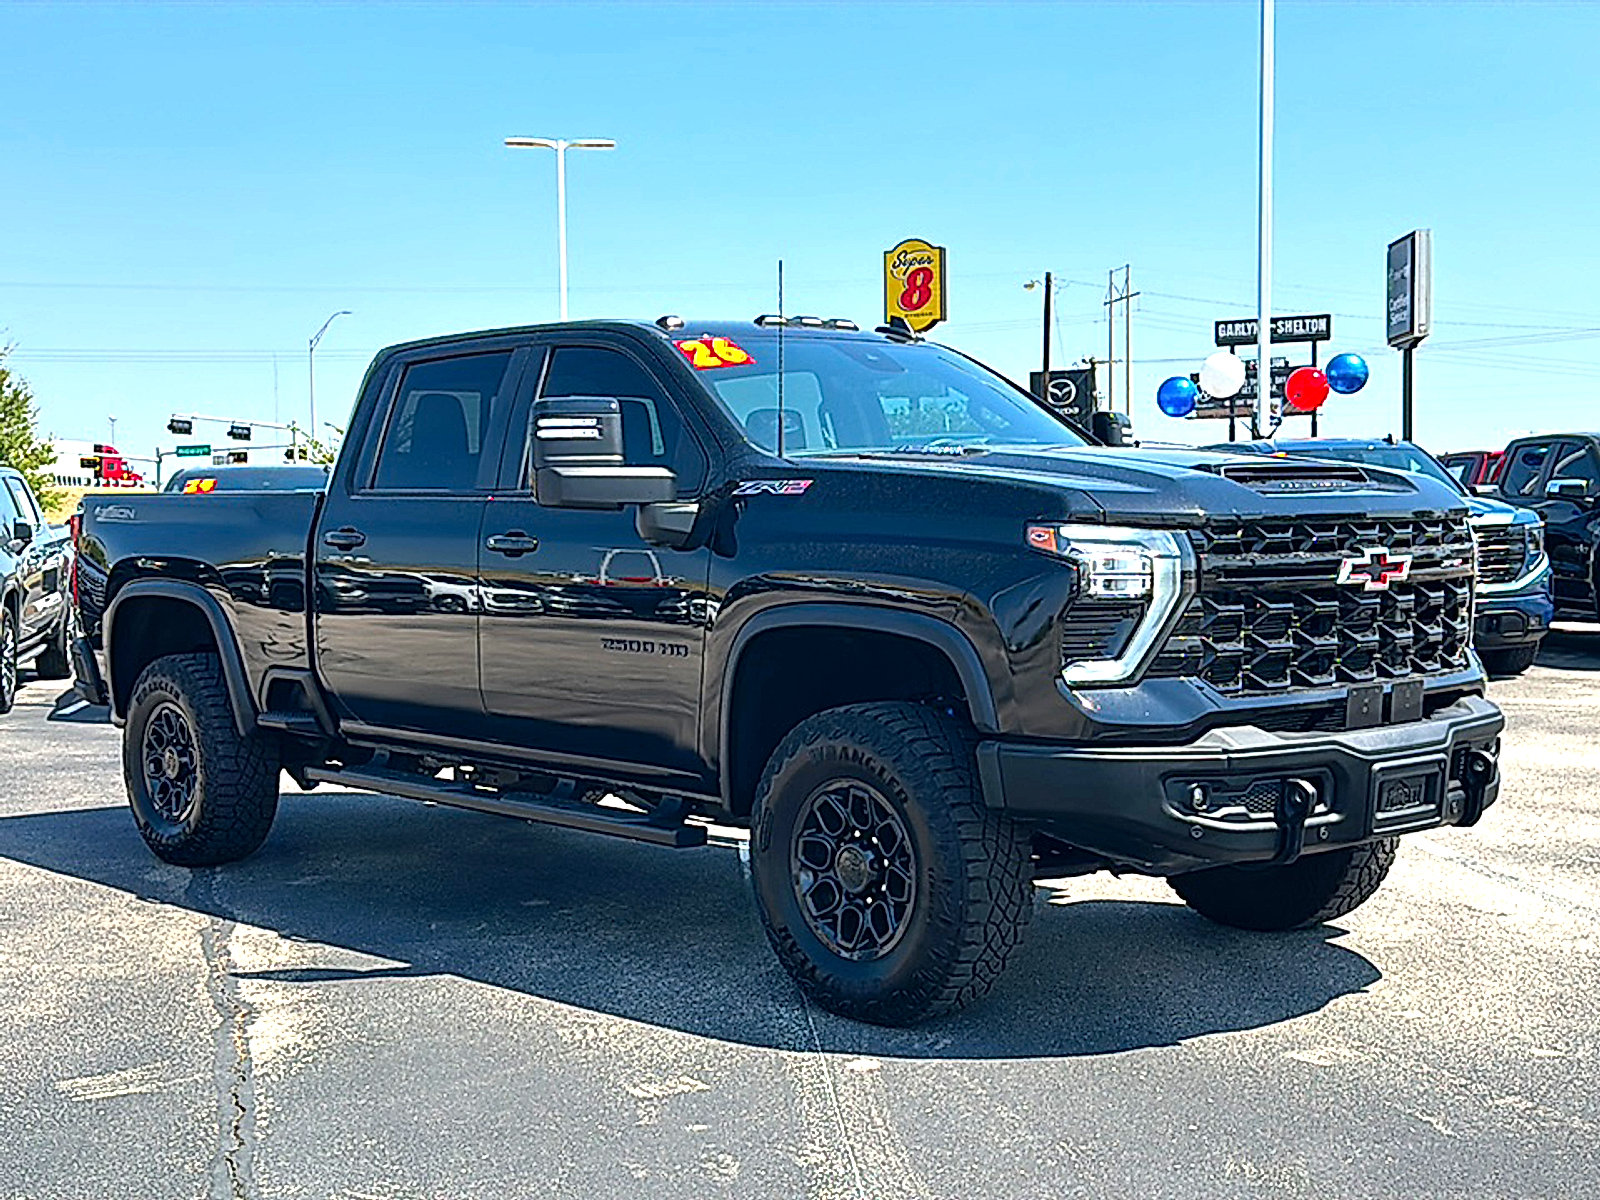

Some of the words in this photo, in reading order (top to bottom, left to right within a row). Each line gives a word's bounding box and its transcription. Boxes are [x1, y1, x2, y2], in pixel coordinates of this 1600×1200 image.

[891, 249, 934, 276] Super
[900, 267, 933, 311] 8
[680, 337, 748, 368] 26
[731, 480, 814, 496] ZR2
[601, 638, 655, 654] 2500
[658, 642, 689, 658] HD
